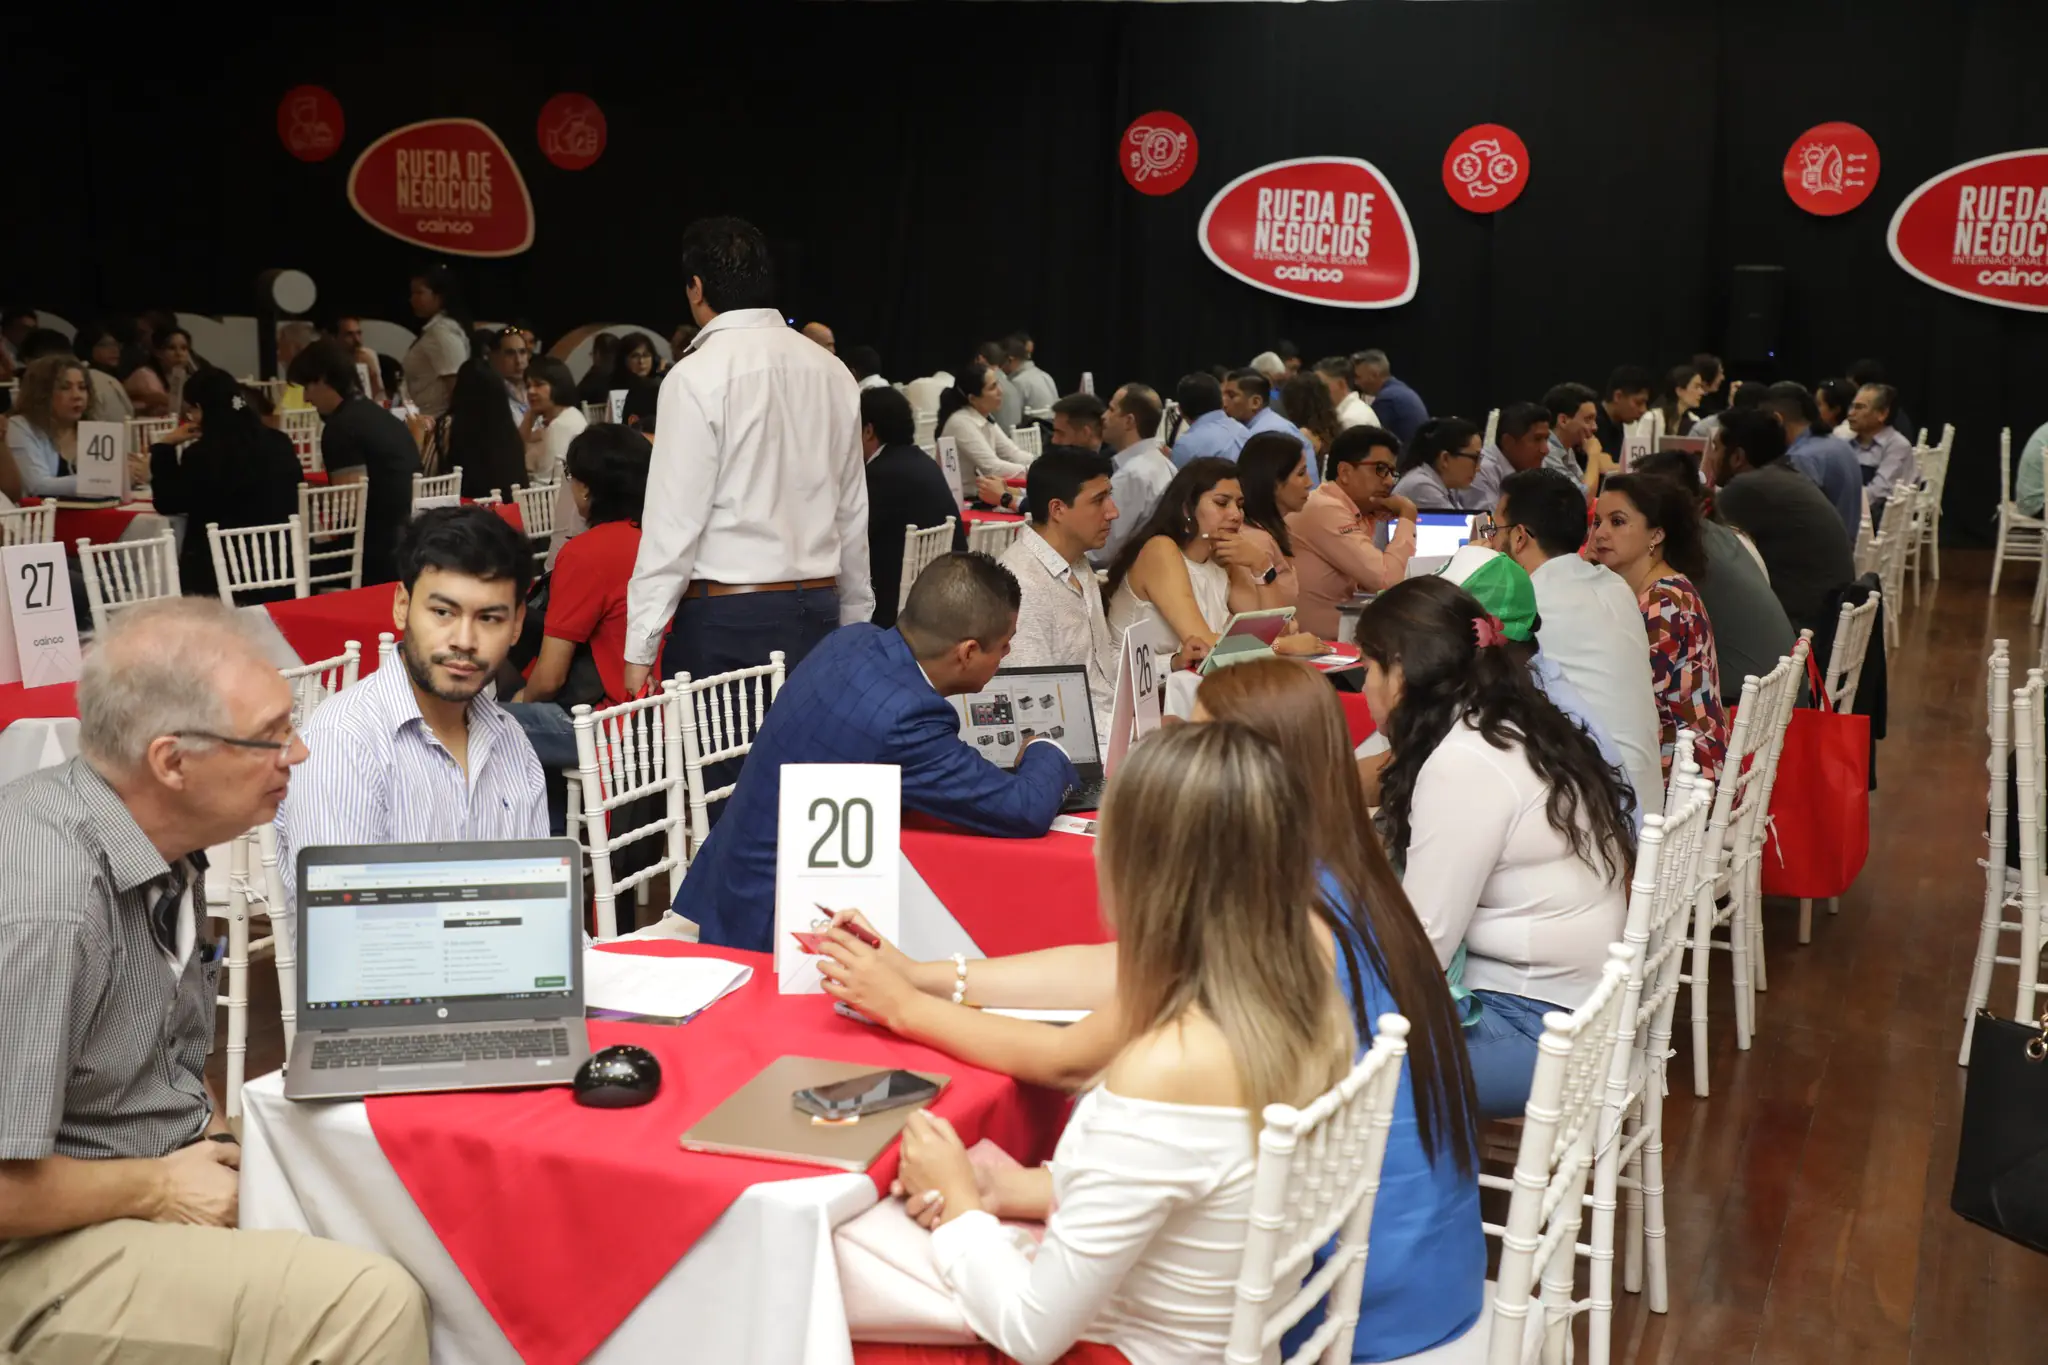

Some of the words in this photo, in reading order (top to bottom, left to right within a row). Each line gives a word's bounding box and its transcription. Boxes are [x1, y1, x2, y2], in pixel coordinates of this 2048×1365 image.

[396, 149, 461, 179] RUEDA
[467, 152, 491, 181] DE
[396, 179, 492, 210] NEGOCIOS
[1258, 188, 1335, 223] RUEDA
[1343, 193, 1375, 225] DE
[1958, 185, 2048, 221] RUEDA
[416, 217, 474, 233] cainco
[1255, 220, 1371, 257] NEGOCIOS
[1953, 221, 2048, 256] NEGOC
[1274, 263, 1344, 283] cainco
[86, 434, 115, 462] 40
[21, 561, 54, 609] 27
[33, 635, 64, 647] cainco
[1136, 643, 1152, 697] 26
[807, 797, 874, 869] 20
